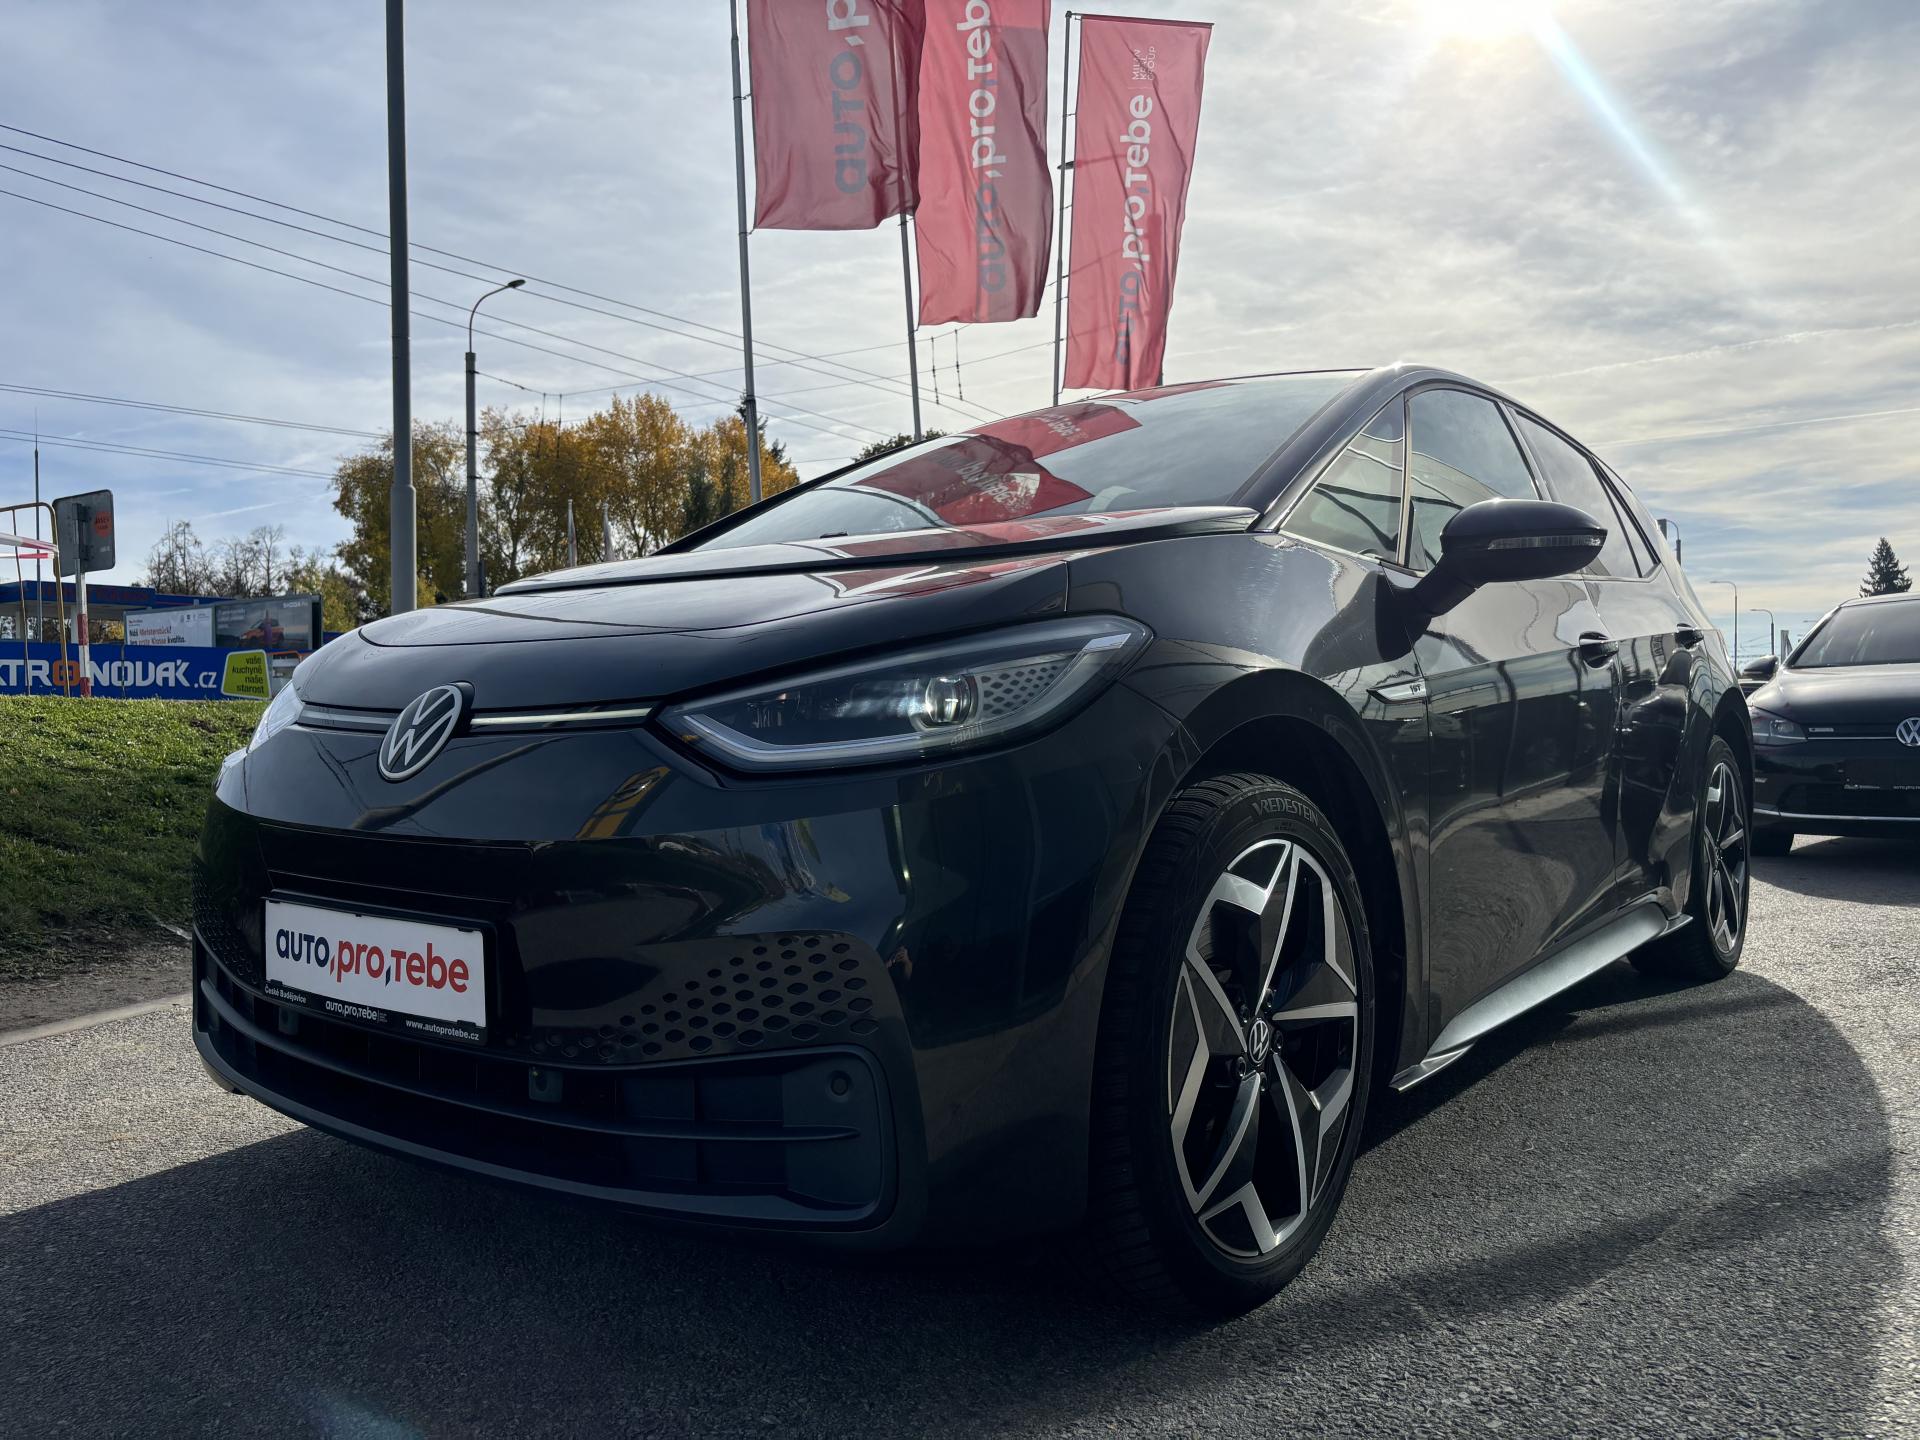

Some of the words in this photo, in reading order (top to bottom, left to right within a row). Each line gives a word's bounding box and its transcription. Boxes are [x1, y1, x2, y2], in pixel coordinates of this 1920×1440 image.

[245, 655, 262, 665] vaše
[245, 675, 264, 684] naše
[236, 684, 265, 694] starost
[1251, 798, 1320, 829] VREDESTEIN
[264, 984, 280, 997] České
[405, 1019, 480, 1041] www.autoprotebe.cz
